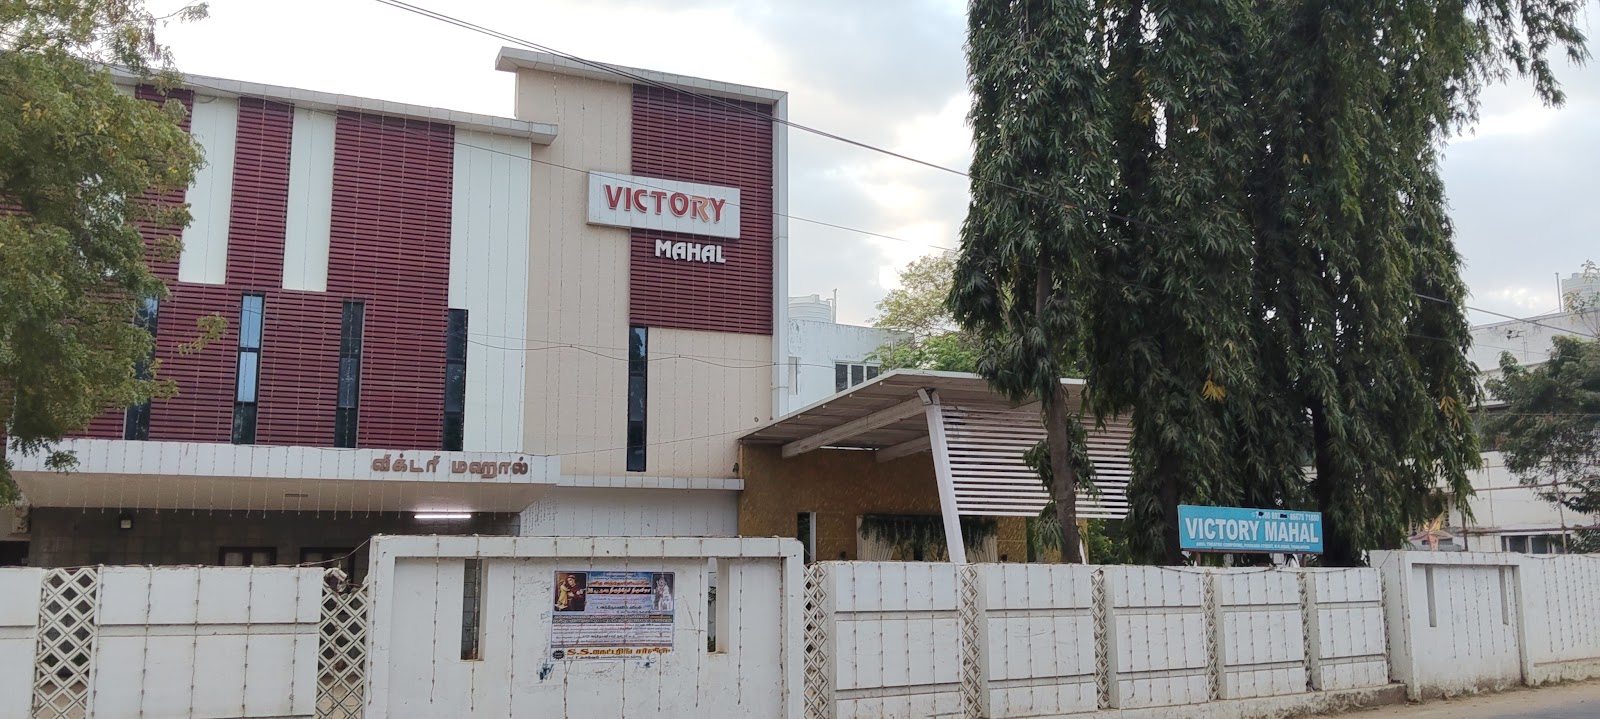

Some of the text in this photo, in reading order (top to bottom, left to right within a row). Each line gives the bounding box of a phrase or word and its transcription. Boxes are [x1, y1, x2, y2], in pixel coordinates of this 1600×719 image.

[603, 184, 726, 224] VICTORY
[655, 239, 726, 264] MAHAL
[452, 456, 528, 479] மஹால்
[1185, 517, 1319, 543] VICTORY MAHAL
